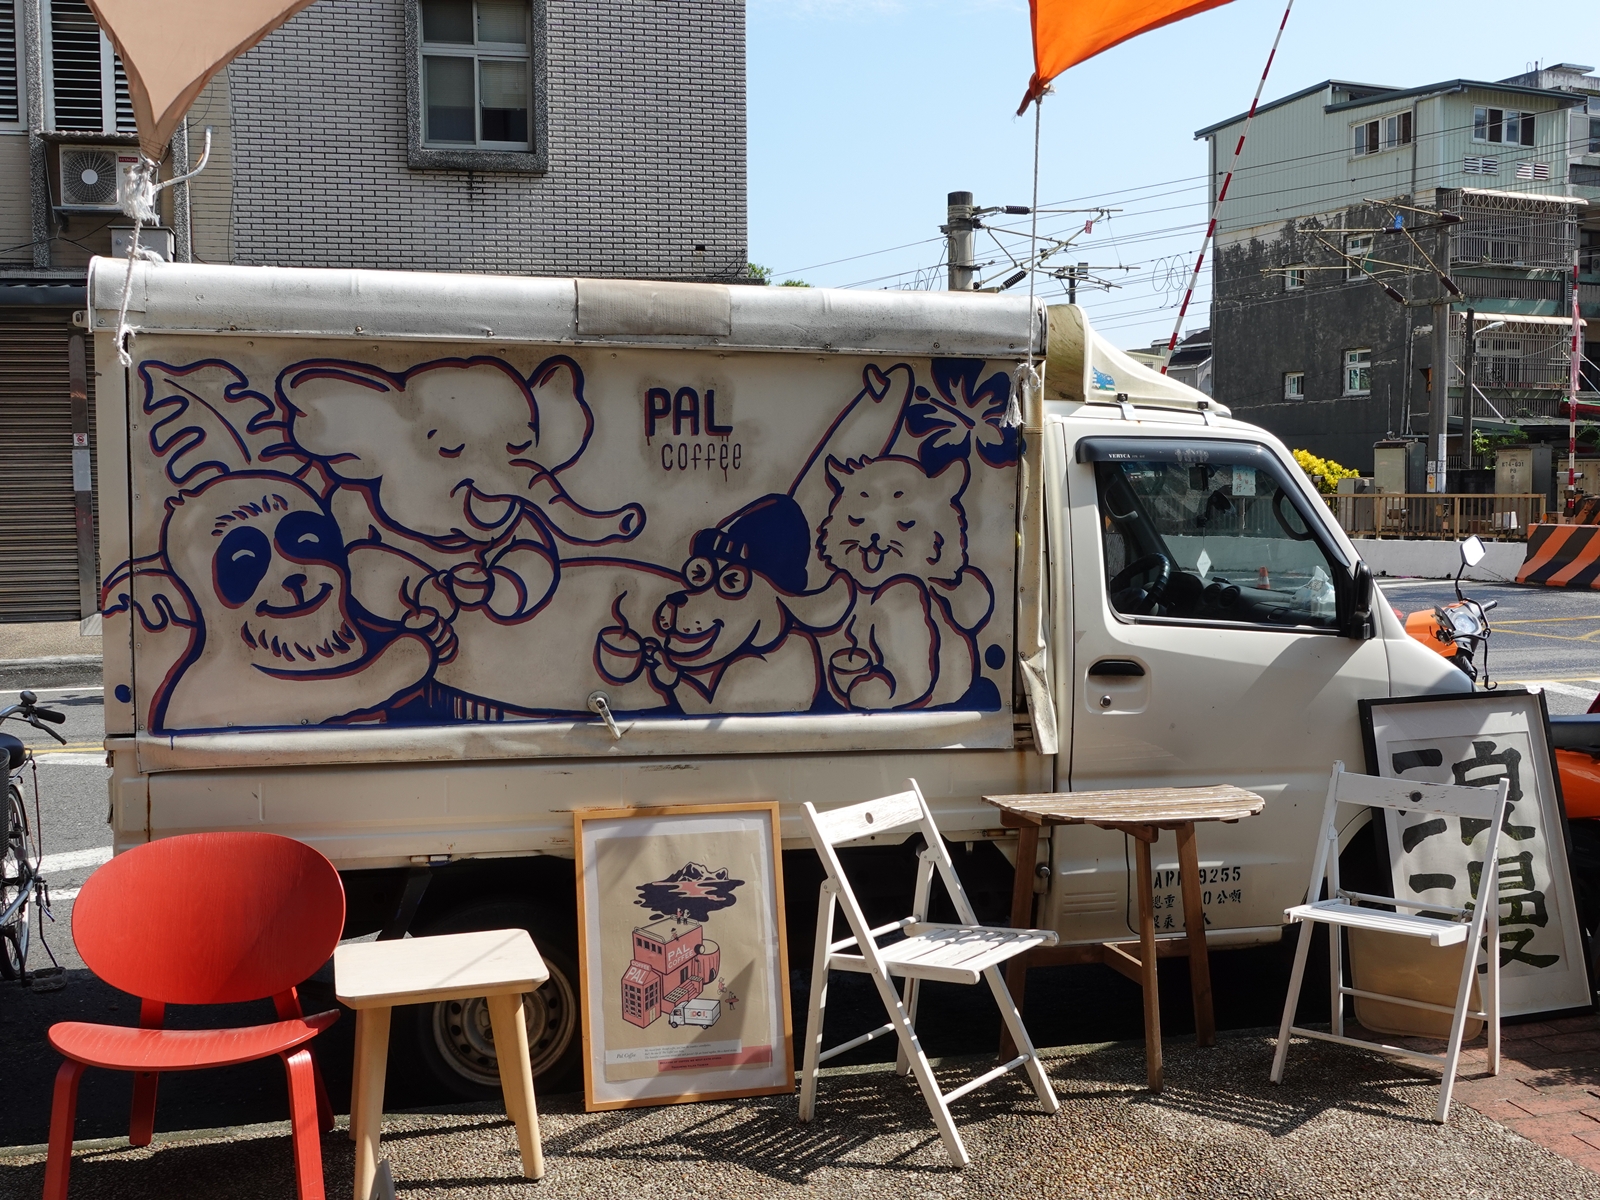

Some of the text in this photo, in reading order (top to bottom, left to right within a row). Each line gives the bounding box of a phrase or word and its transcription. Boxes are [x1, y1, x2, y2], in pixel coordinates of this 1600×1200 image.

[644, 387, 734, 437] PAL
[667, 943, 691, 962] PAL
[668, 949, 694, 969] COFFEE
[626, 967, 645, 984] PAL
